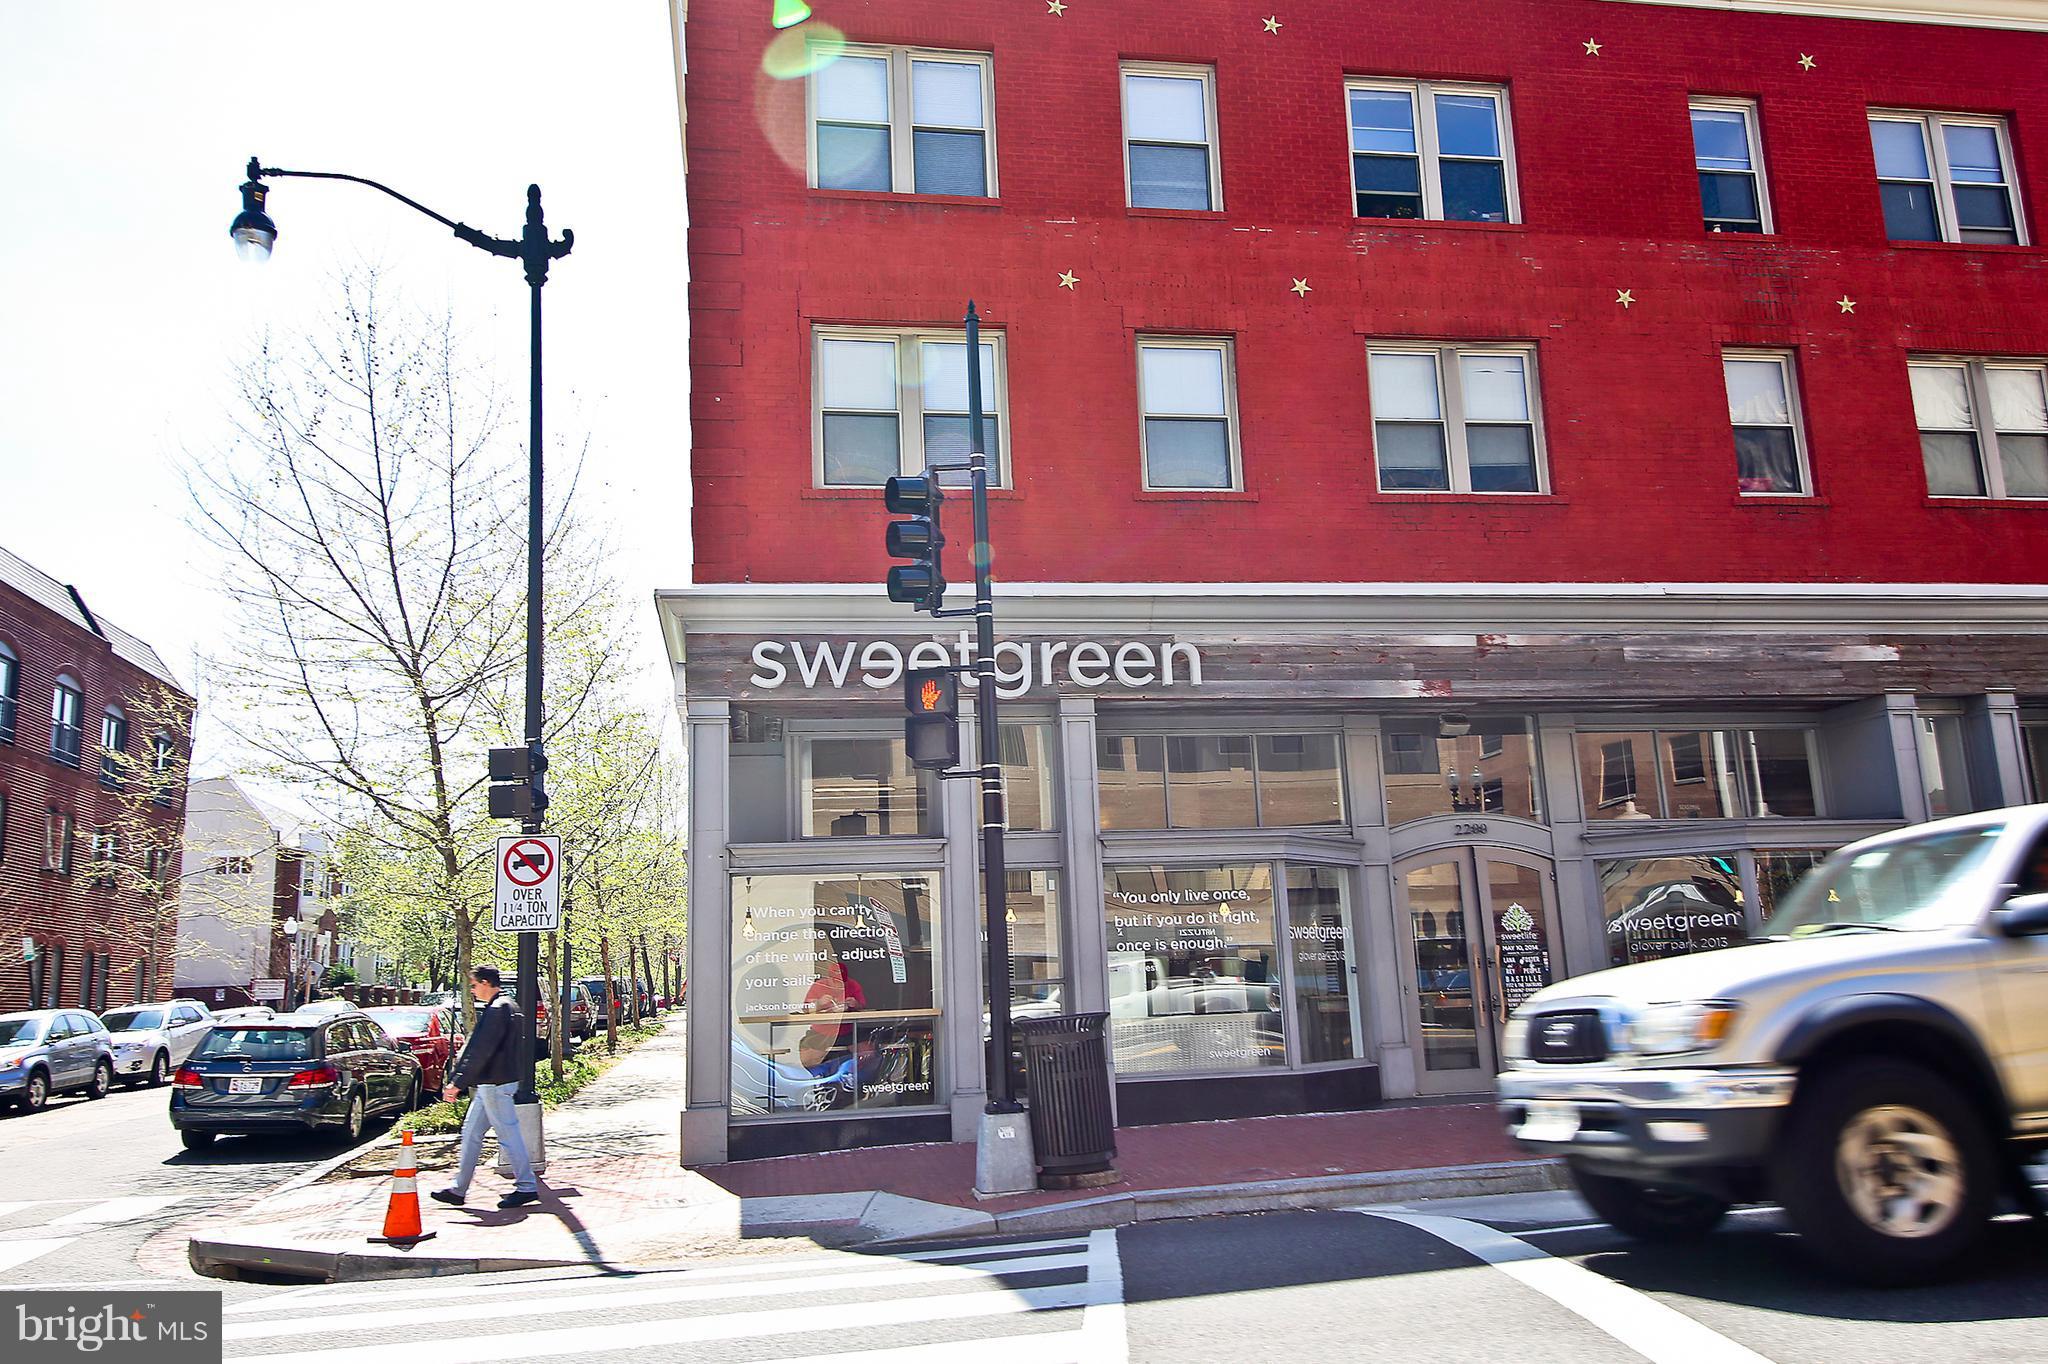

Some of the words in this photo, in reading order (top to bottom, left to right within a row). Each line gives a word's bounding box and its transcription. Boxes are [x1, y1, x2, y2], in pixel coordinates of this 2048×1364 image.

[750, 630, 1203, 699] sweetgreen
[512, 888, 542, 901] OVER
[1150, 889, 1180, 903] only
[1185, 888, 1210, 902] live
[1213, 888, 1250, 901] once,
[527, 900, 548, 914] TON
[799, 905, 826, 919] you
[500, 914, 552, 928] CAPACITY
[1114, 914, 1140, 927] but
[1143, 914, 1153, 926] if
[1155, 914, 1182, 928] you
[1186, 911, 1205, 925] do
[1208, 911, 1219, 924] it
[1609, 911, 1738, 932] sweetgreen
[745, 929, 799, 943] change
[803, 927, 827, 940] the
[829, 924, 894, 939] direction
[1289, 925, 1348, 942] sweetgreen
[1116, 938, 1151, 952] once
[1155, 937, 1166, 950] is
[1631, 940, 1666, 953] glover
[1671, 939, 1698, 950] park
[745, 951, 761, 964] of
[765, 951, 789, 963] the
[793, 948, 828, 962] wind
[841, 947, 886, 962] adjust
[745, 977, 778, 990] your
[1505, 975, 1543, 983] BASTILLE
[745, 1003, 780, 1013] jackson
[862, 1081, 930, 1094] sweetgreen
